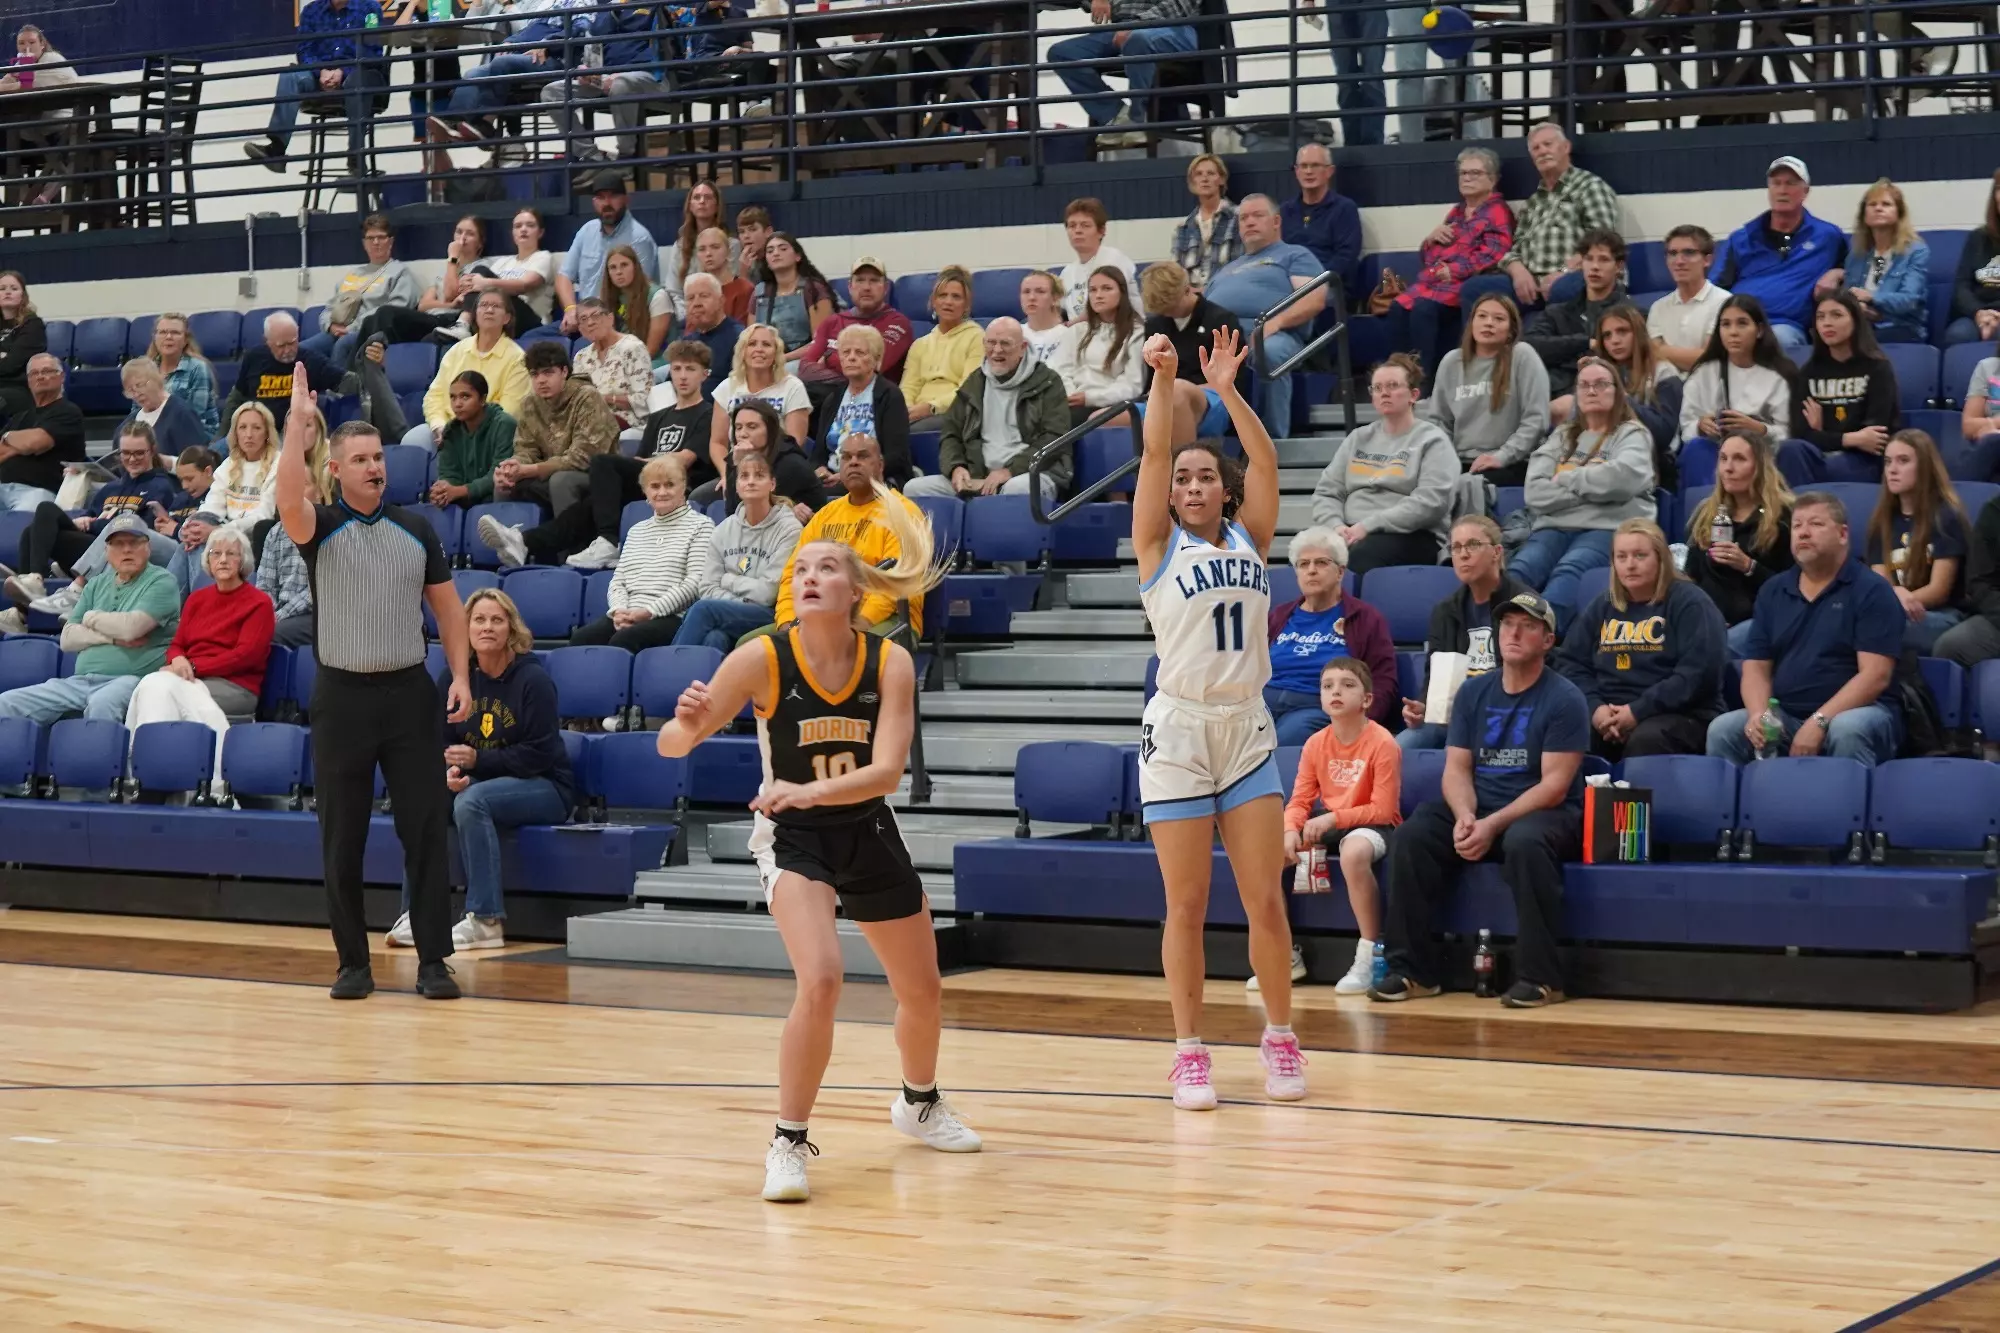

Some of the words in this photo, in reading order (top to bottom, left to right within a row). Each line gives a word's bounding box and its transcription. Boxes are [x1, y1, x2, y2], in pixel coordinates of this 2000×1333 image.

[1175, 558, 1269, 600] LANCERS
[1212, 601, 1243, 651] 11
[799, 717, 870, 745] DORDT
[1480, 747, 1528, 758] UNDER
